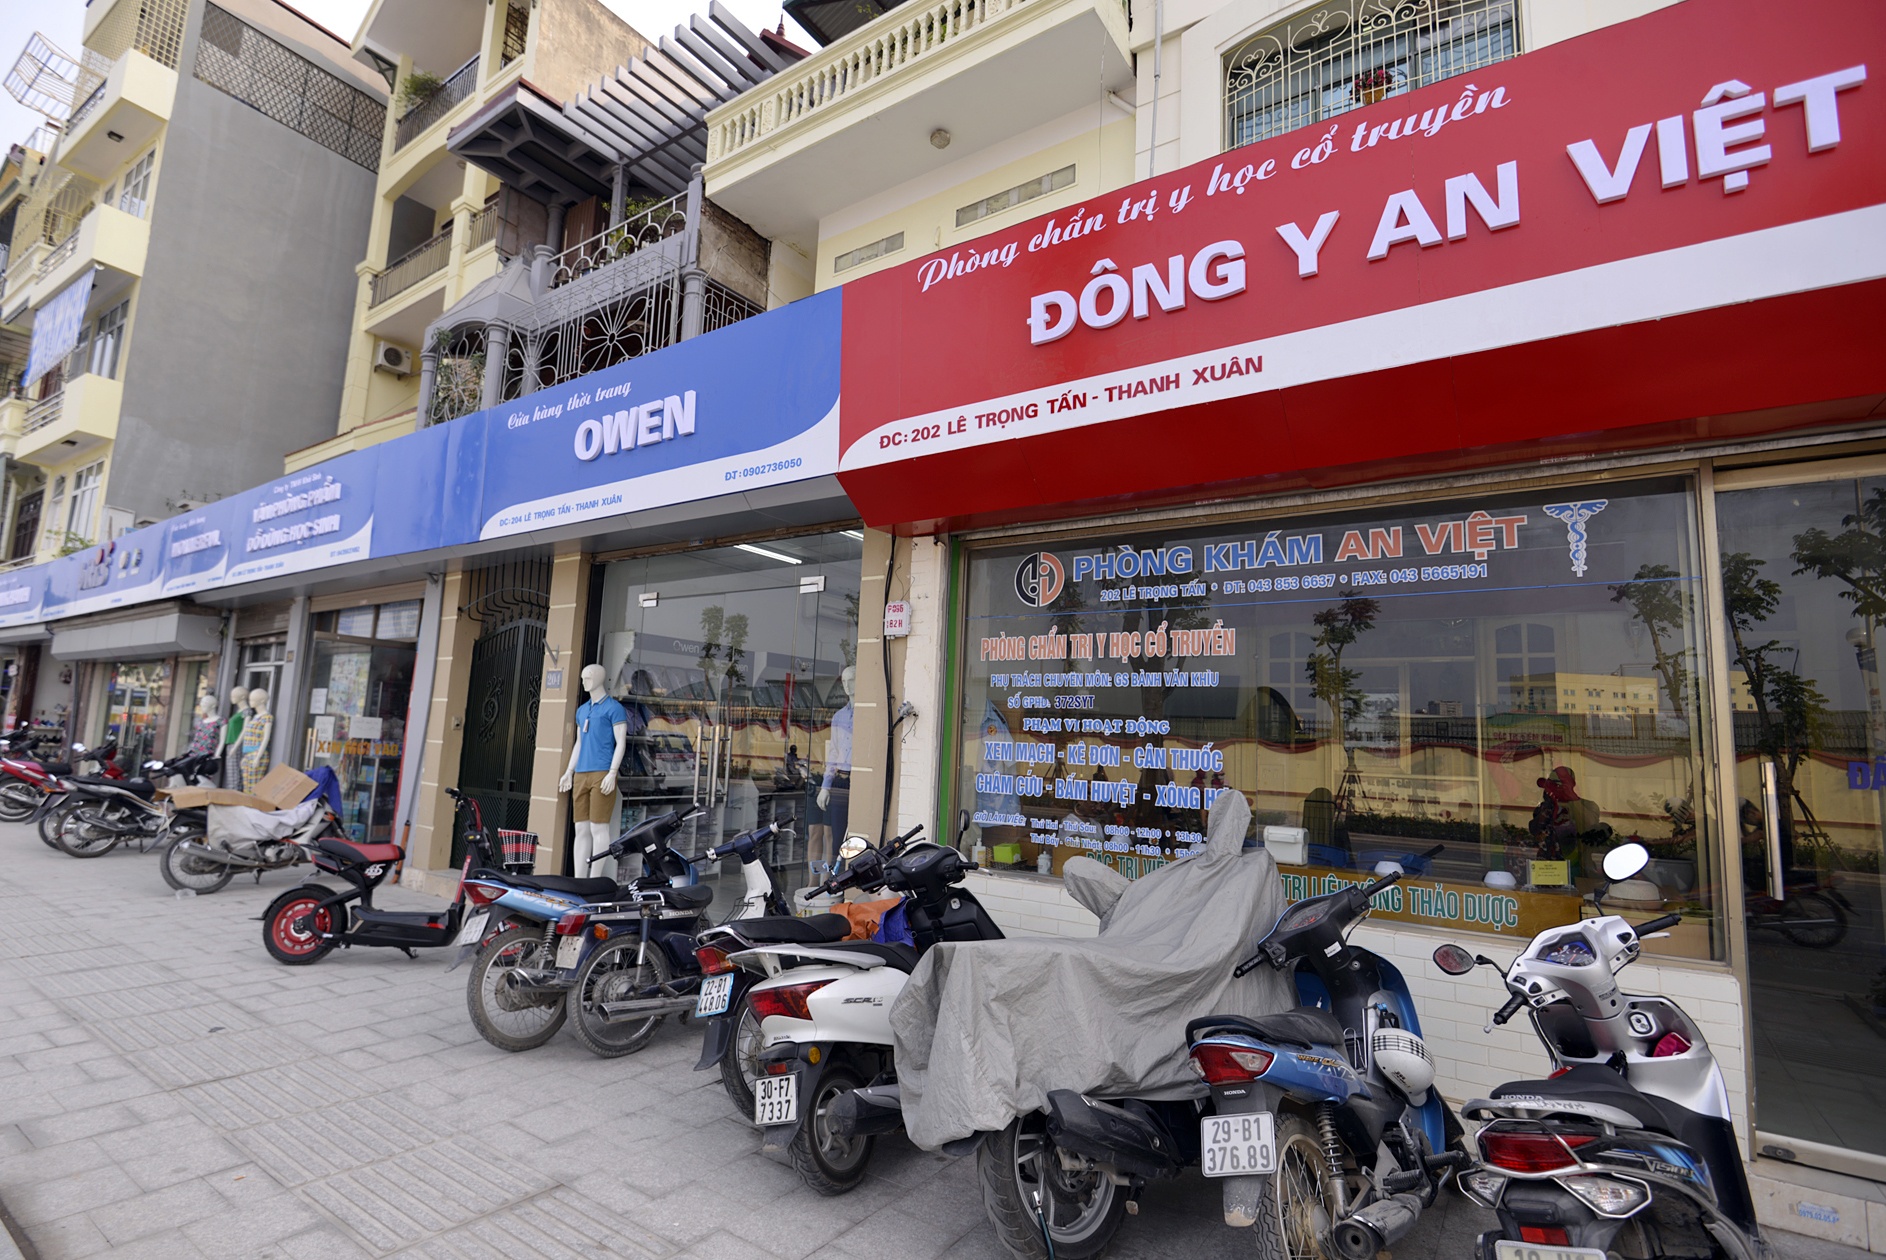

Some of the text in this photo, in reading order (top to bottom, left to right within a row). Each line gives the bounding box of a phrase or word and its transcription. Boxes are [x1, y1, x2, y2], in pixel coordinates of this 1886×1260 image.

[918, 83, 1512, 293] Phòng chẩn trị y học cổ truyền
[1026, 63, 1867, 346] ĐÔNG Y AN VIỆT
[507, 381, 632, 430] Cửa hàng thời trang
[947, 415, 967, 435] LÊ
[975, 402, 1039, 429] TRỌNG
[1046, 389, 1087, 414] TẤN
[1104, 372, 1180, 403] THANH
[1192, 355, 1263, 386] XUÂN
[574, 389, 697, 462] OWEN
[524, 511, 532, 522] LÊ
[534, 508, 556, 521] TRỌNG
[557, 503, 571, 515] TẤN
[575, 501, 599, 512] THANH
[601, 494, 622, 507] XUÂN
[1073, 510, 1528, 582] PHÒNG KHÁM AN VIỆT
[1100, 563, 1488, 602] 202 LÊ TRỌNG TẤN ĐT: 043 853 6637 FAX: 043 5665191
[673, 640, 700, 654] Owen
[980, 619, 1236, 663] PHÒNG CHẨN TRỊ Y HỌC CỔ TRUYỀN
[990, 673, 1010, 691] PHỤ
[1011, 669, 1042, 688] TRÁCH
[1043, 671, 1084, 687] CHUYÊN
[1085, 669, 1113, 687] MÔN:
[1114, 673, 1130, 688] GS
[1131, 669, 1162, 687] BÀNH
[1163, 668, 1189, 687] VĂN
[1007, 692, 1022, 709] SỐ
[1054, 695, 1095, 709] 372SYT
[1023, 716, 1170, 738] PHẠM VI HOẠT ĐỘNG
[984, 741, 1013, 761] XEM
[1015, 743, 1056, 766] MẠCH
[1067, 741, 1087, 765] KÊ
[1089, 745, 1120, 767] ĐƠN
[1134, 744, 1167, 770] CÂN
[1169, 742, 1223, 773] THUỐC
[975, 772, 1014, 795] CHÂM
[1016, 770, 1045, 797] CỨU
[1055, 772, 1087, 801] BẤM
[1090, 780, 1137, 808] HUYỆT
[1155, 781, 1201, 809] XÔNG
[973, 809, 988, 821] GIỜ
[988, 811, 1007, 824] LÀM
[1007, 813, 1027, 826] VIỆC:
[1030, 818, 1045, 829] Thứ
[1045, 819, 1059, 830] Hai
[1064, 820, 1079, 831] Thứ
[1079, 821, 1097, 833] Sáu:
[1104, 825, 1130, 837] 08h00
[1136, 828, 1162, 839] 12h00
[1175, 831, 1202, 843] 13h30
[1030, 833, 1045, 844] Thứ
[1045, 833, 1060, 848] Bảy
[1065, 836, 1081, 849] Chủ
[1104, 843, 1129, 853] 08h00
[1136, 845, 1161, 856] 11h30
[668, 909, 694, 917] HONDA
[1407, 883, 1460, 920] THẢO
[1463, 893, 1518, 931] DƯỢC
[760, 1099, 791, 1121] 7337
[1211, 1117, 1262, 1144] 29-B1
[1206, 1143, 1271, 1172] 376.89
